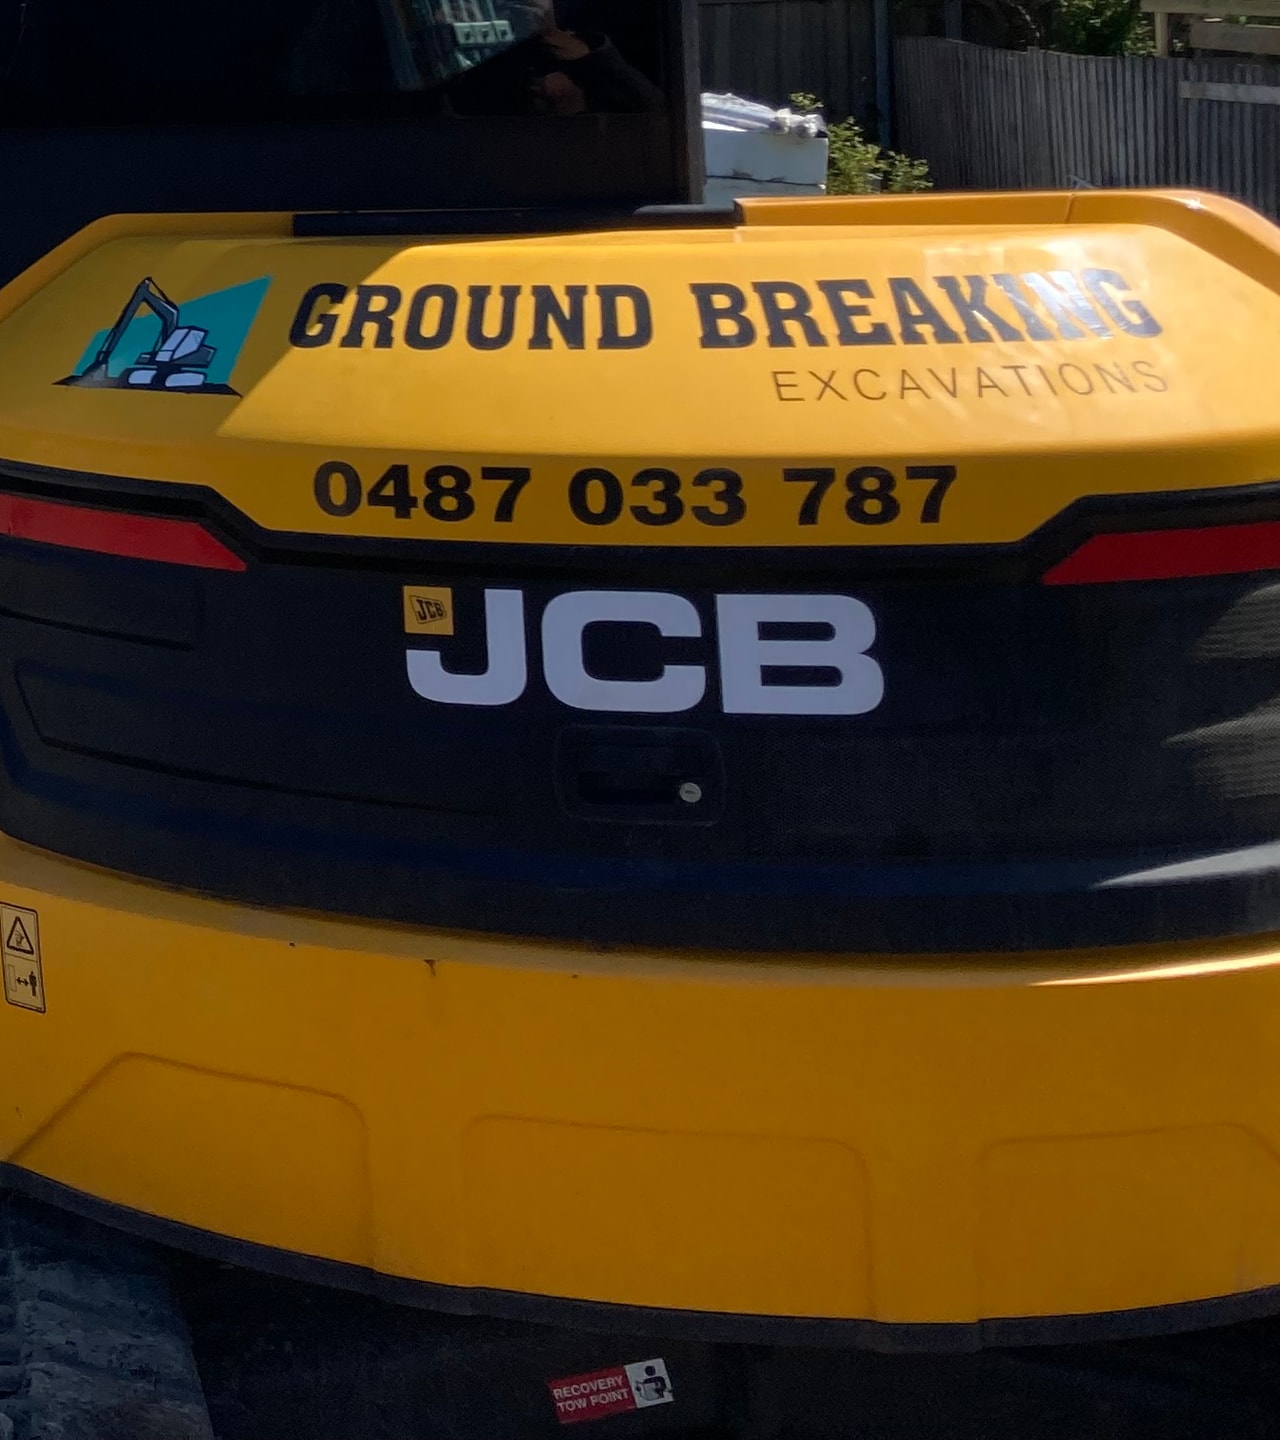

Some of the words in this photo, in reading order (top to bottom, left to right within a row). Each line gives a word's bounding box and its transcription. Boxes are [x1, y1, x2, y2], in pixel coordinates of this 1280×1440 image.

[289, 282, 653, 350] GROUND
[689, 268, 1164, 348] BREAKING
[771, 360, 1168, 402] EXCAVATIONS
[313, 461, 531, 522] 0487
[568, 467, 748, 526] 033
[782, 465, 958, 525] 787
[415, 598, 444, 621] JCB
[405, 588, 885, 715] JCB
[553, 1375, 623, 1400] RECOVERY
[557, 1399, 588, 1412] TOW
[590, 1388, 628, 1406] POINT
